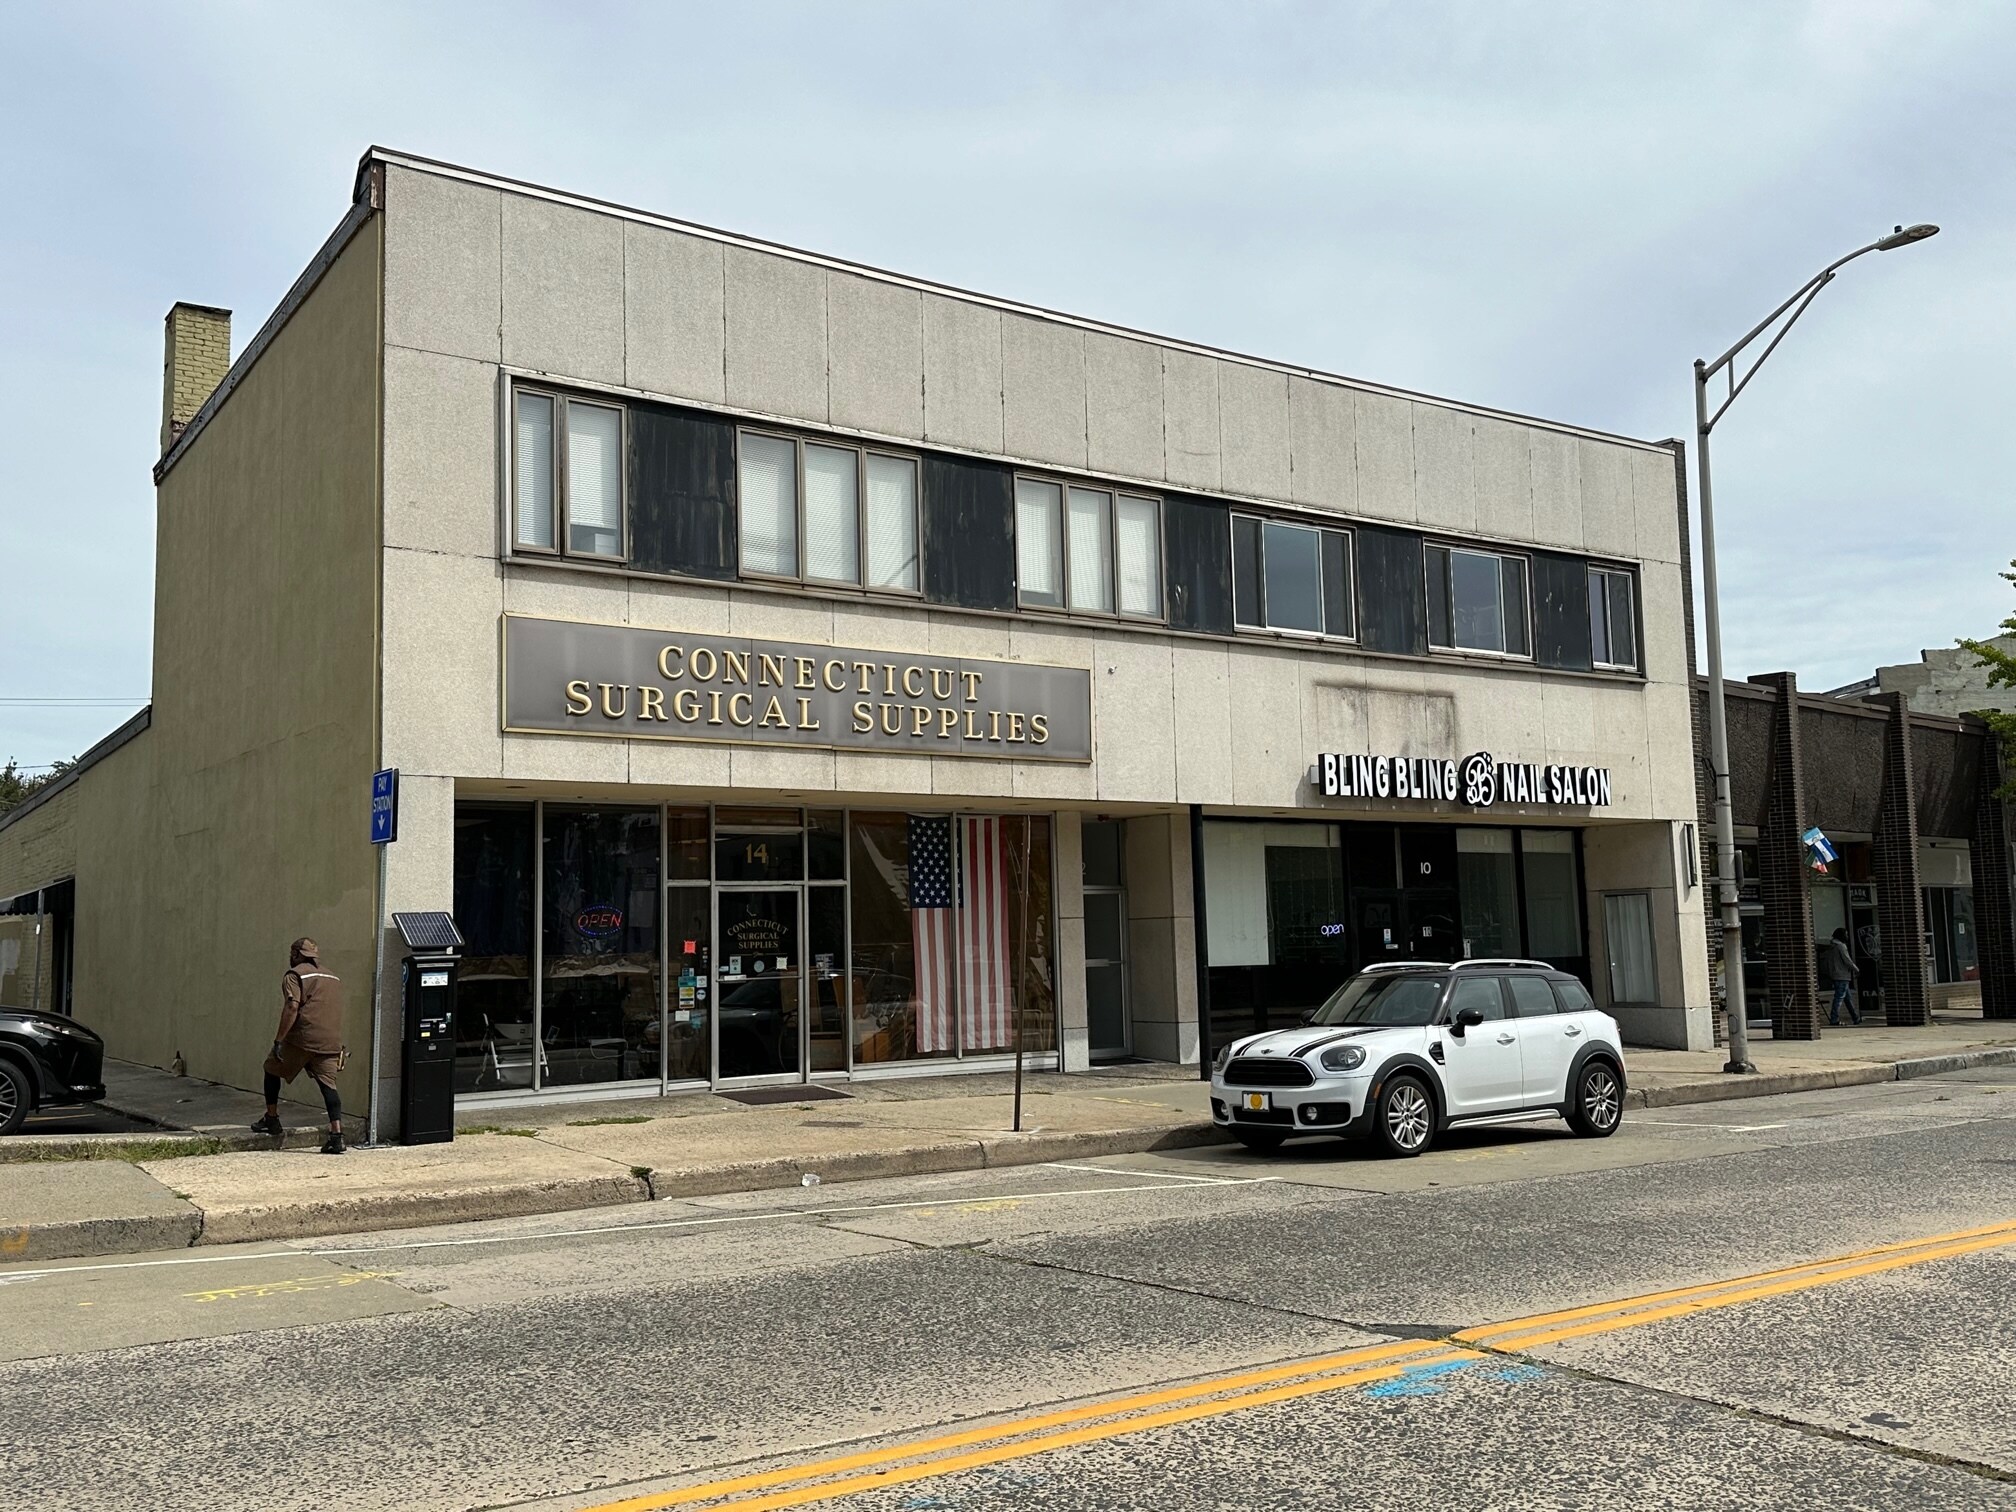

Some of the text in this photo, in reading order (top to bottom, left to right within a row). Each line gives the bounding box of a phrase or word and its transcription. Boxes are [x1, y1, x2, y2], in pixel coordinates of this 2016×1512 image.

[657, 645, 983, 703] CONNECTICUT
[565, 680, 1050, 745] SURGICAL SUPPLIES
[378, 775, 388, 793] PAY
[1323, 753, 1457, 800] BLING BLING
[1502, 762, 1612, 806] NAIL SALON
[745, 843, 768, 864] 14
[1420, 862, 1431, 874] 10
[577, 911, 622, 929] OPEN
[727, 918, 789, 937] CONNECTICUT
[737, 932, 780, 941] SURGICAL
[1320, 923, 1344, 937] open
[738, 940, 779, 950] SUPPLIES
